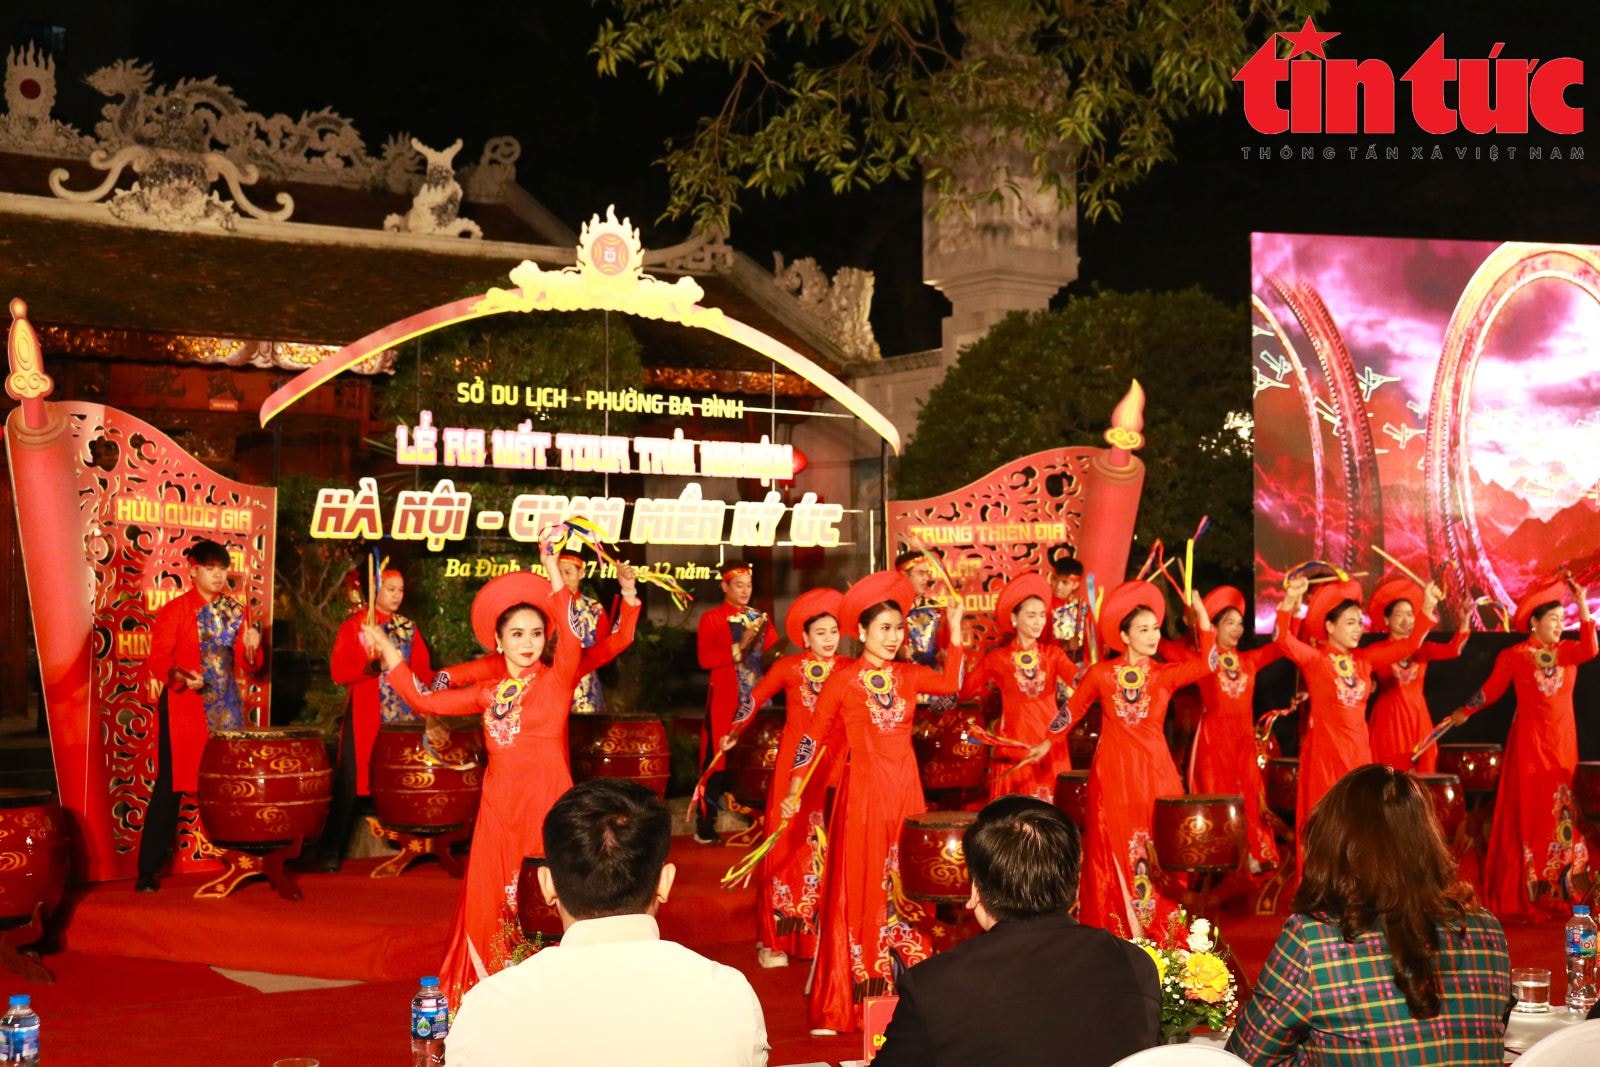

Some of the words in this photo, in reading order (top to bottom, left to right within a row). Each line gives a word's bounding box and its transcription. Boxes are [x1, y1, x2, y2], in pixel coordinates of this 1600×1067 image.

[457, 375, 485, 404] SỞ
[491, 384, 519, 406] DU
[525, 386, 567, 411] LỊCH
[586, 387, 664, 414] PHƯỜNG
[668, 396, 693, 416] BA
[701, 396, 744, 419] ĐÌNH
[443, 427, 486, 467] RA
[492, 418, 552, 470] MẮT
[555, 432, 630, 474] TOUR
[117, 495, 160, 523] HỮU
[164, 496, 217, 528] QUỐC
[221, 509, 251, 531] GIA
[309, 476, 383, 540] HÀ
[391, 478, 472, 552] NỘI
[629, 482, 726, 545] MIỀN
[730, 491, 786, 547] KÝ
[789, 492, 844, 548] ỨC
[910, 526, 973, 543] TRUNG
[976, 522, 1031, 543] THIÊN
[1034, 522, 1066, 545] ĐỊA
[445, 558, 471, 577] Ba
[675, 562, 711, 580] năm
